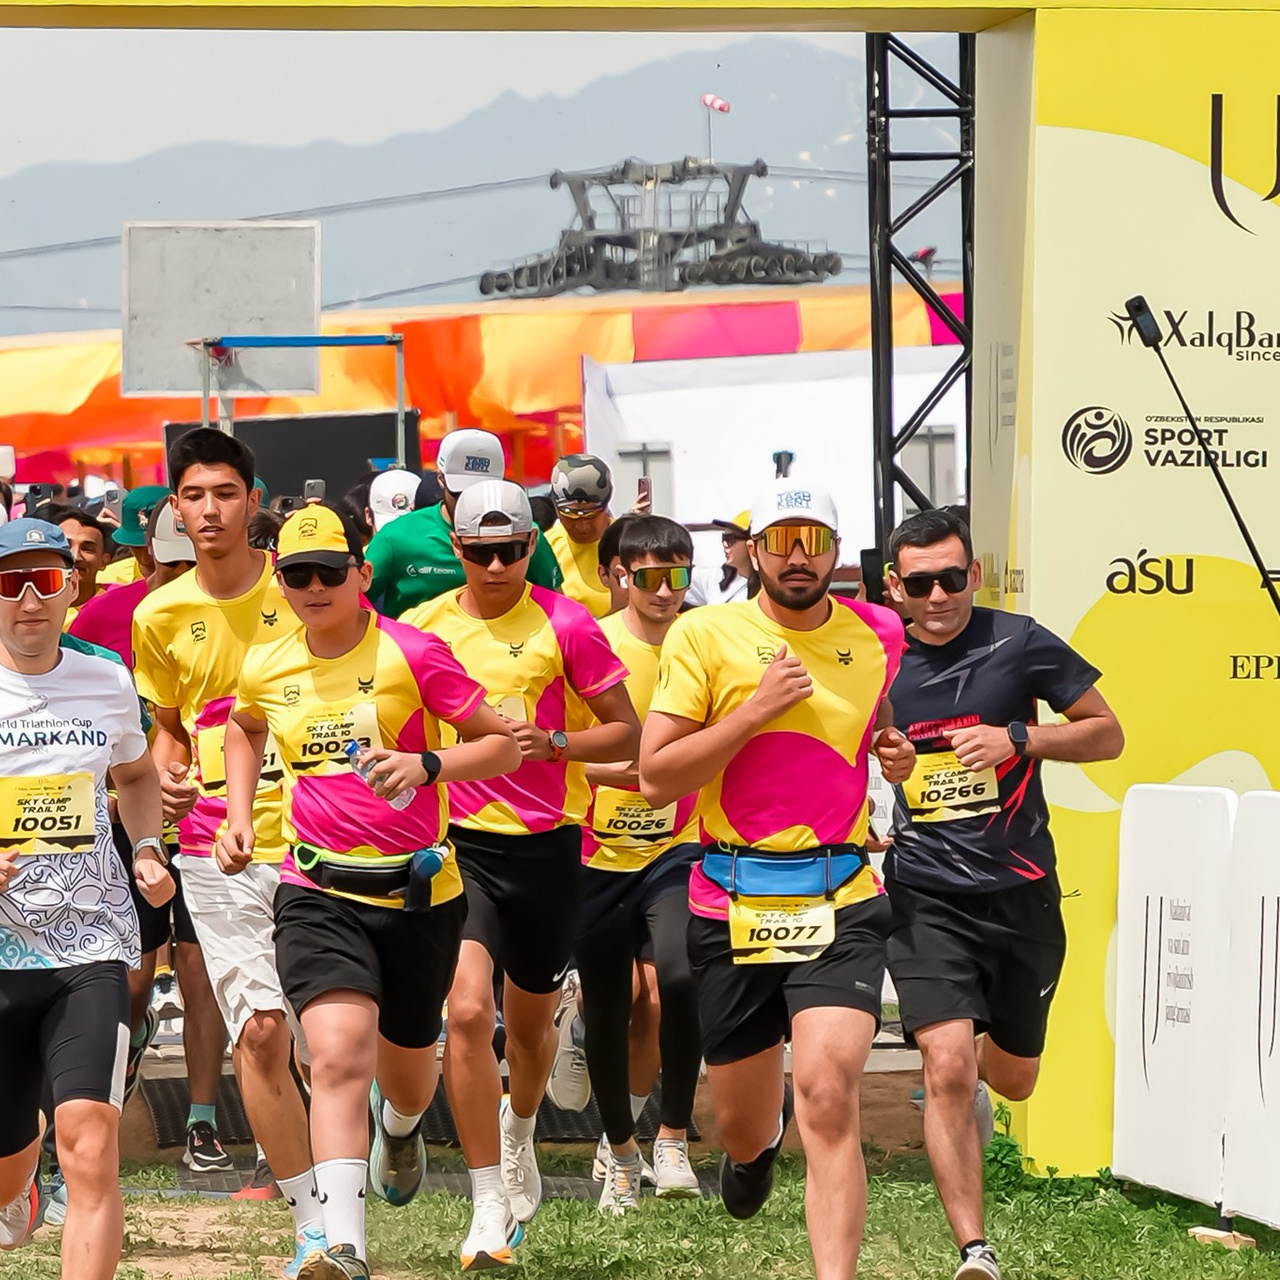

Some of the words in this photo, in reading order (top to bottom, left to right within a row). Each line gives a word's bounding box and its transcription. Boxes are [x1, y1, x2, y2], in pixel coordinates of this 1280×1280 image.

[1235, 350, 1280, 362] since
[1204, 415, 1265, 423] RESPUBLIKASI
[1144, 427, 1229, 446] SPORT
[1143, 449, 1268, 468] VAZIRLIGI
[433, 566, 456, 575] team
[20, 718, 70, 729] Triathlon
[71, 718, 93, 728] Cup
[306, 725, 325, 733] SKY
[327, 722, 355, 731] CAMP
[311, 731, 338, 740] TRAIL
[923, 773, 941, 782] SKY
[928, 779, 955, 787] TRAIL
[920, 782, 987, 804] 10266
[16, 798, 39, 806] SKY
[42, 797, 71, 805] CAMP
[22, 806, 53, 814] TRAIL
[55, 805, 66, 813] 10
[12, 815, 82, 833] 10051
[606, 818, 668, 831] 10026
[748, 925, 822, 942] 10077
